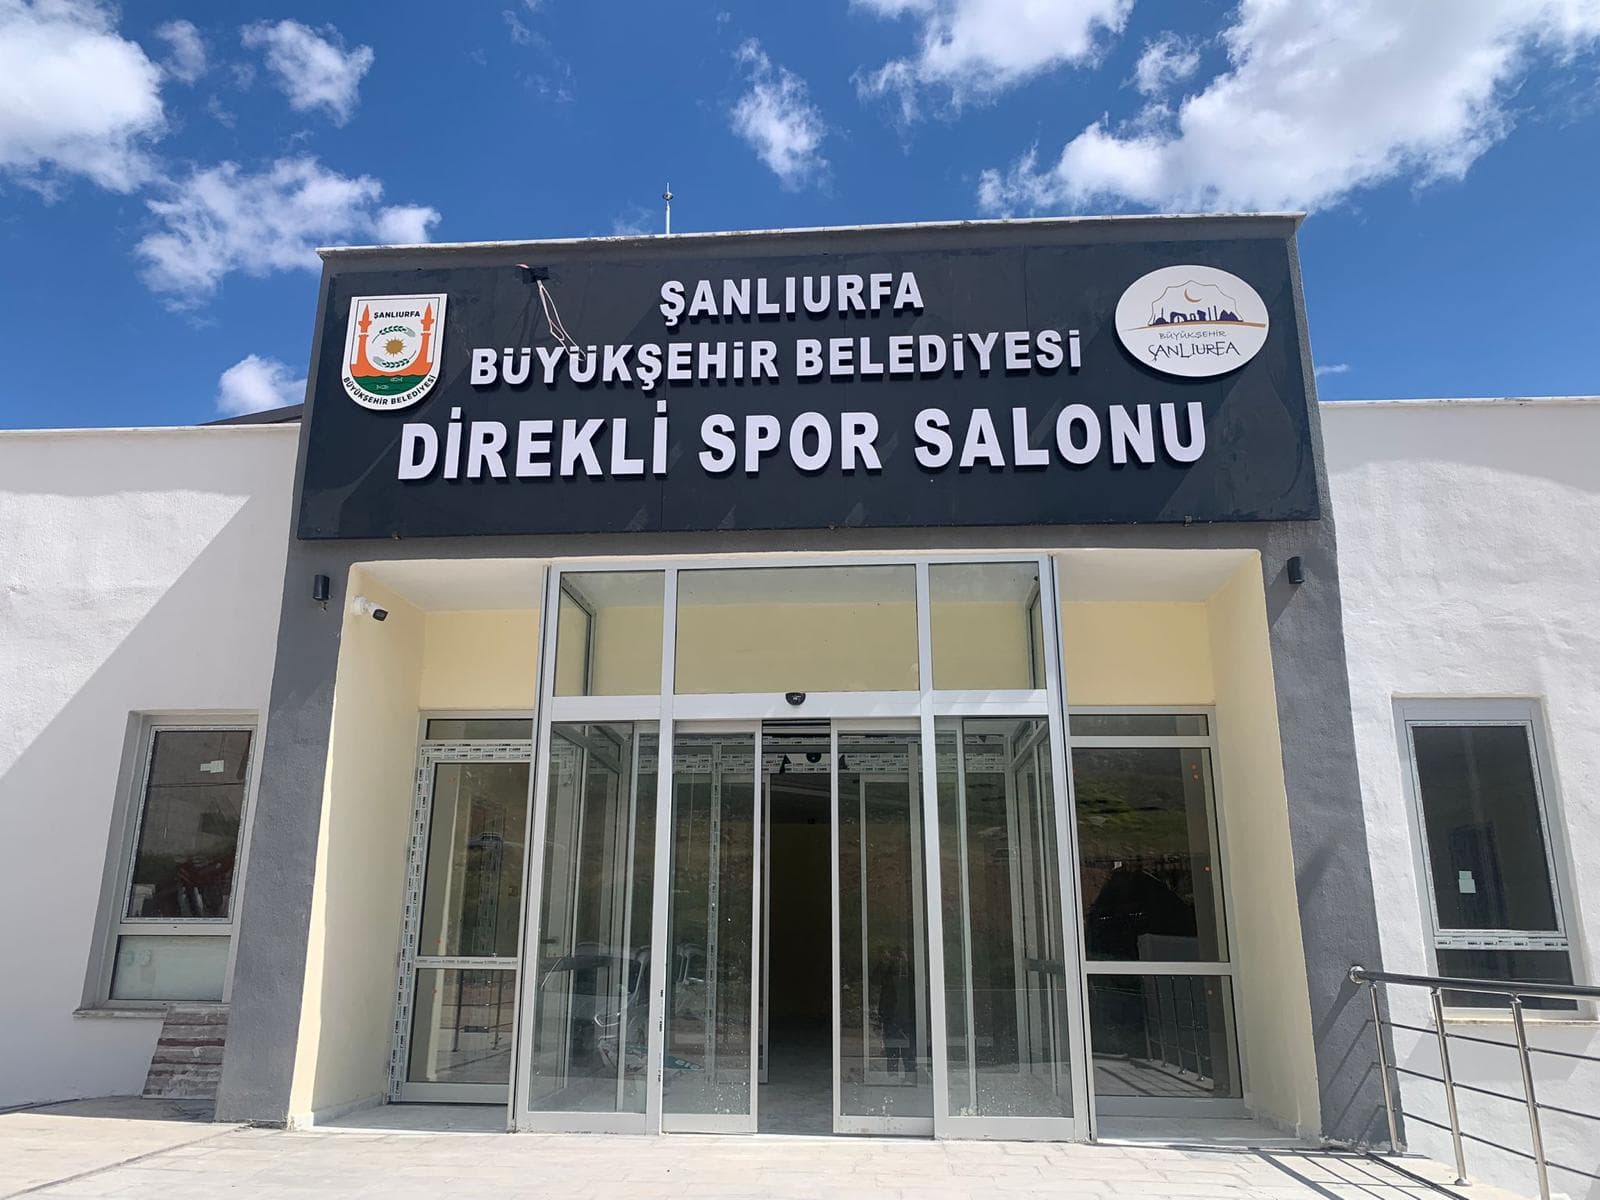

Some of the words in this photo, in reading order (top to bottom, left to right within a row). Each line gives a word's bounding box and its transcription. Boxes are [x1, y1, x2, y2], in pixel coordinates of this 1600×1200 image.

[374, 311, 420, 319] ŞANLIURFA
[660, 271, 925, 327] ŞANLIURFA
[470, 340, 780, 391] BÜYÜKŞEHİR
[796, 329, 1081, 377] BELEDİYESİ
[391, 374, 436, 405] BELEDİYESİ
[398, 400, 668, 480] DİREKLİ
[699, 411, 883, 473] SPOR
[914, 401, 1206, 468] SALONU
